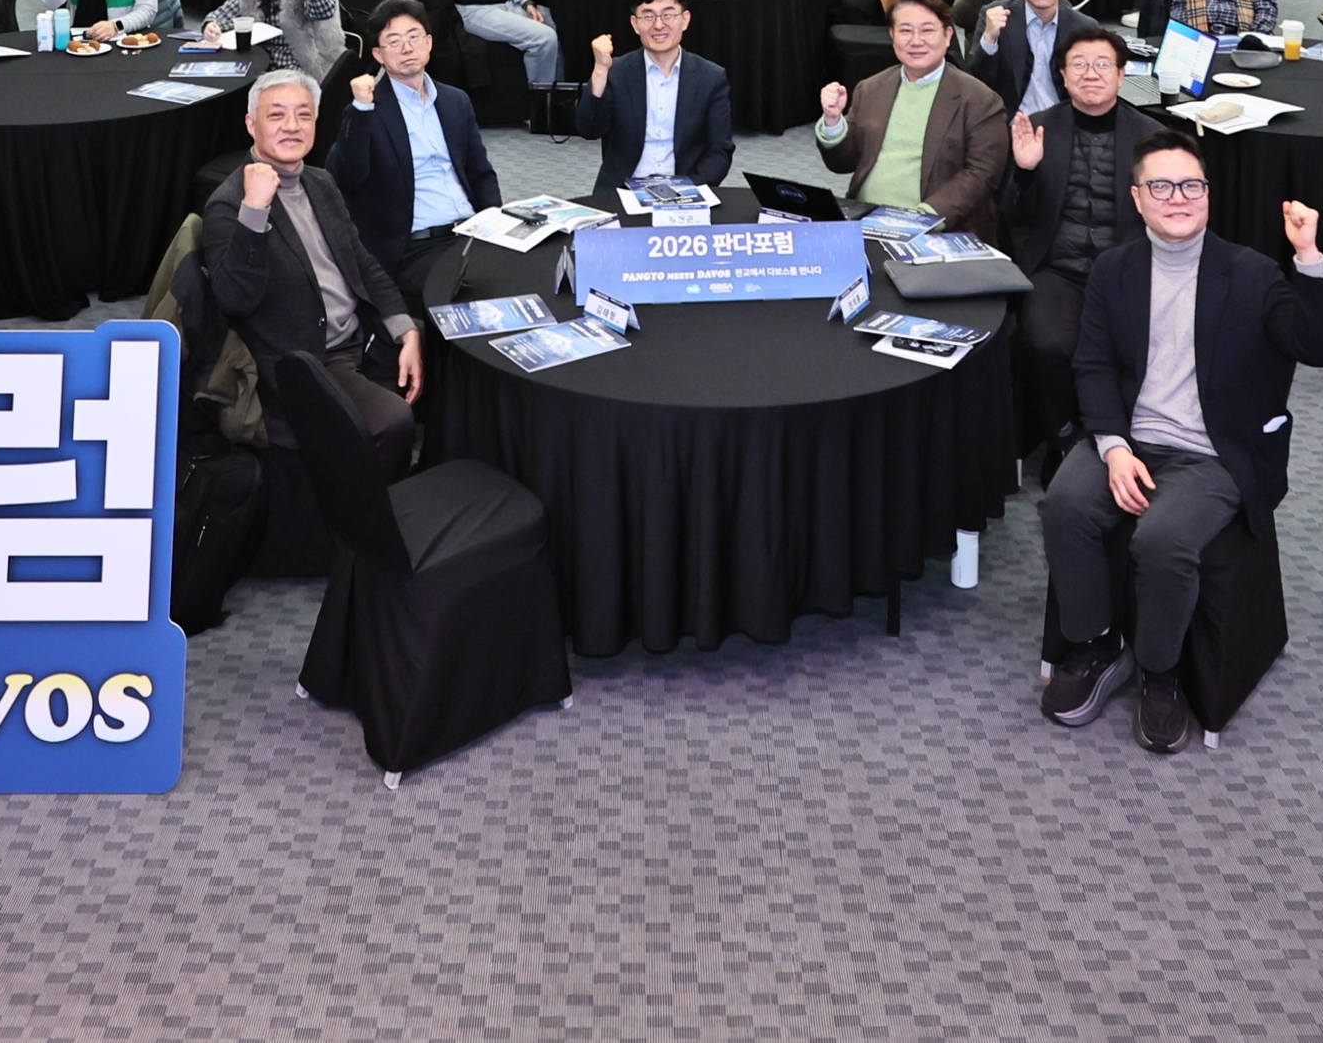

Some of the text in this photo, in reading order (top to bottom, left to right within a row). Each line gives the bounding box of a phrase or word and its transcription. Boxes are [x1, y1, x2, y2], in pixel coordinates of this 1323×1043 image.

[648, 231, 794, 258] 2026 판다포럼
[622, 266, 822, 282] PANGYO MEETS DAVOS 판교에서 다보스를 만나다
